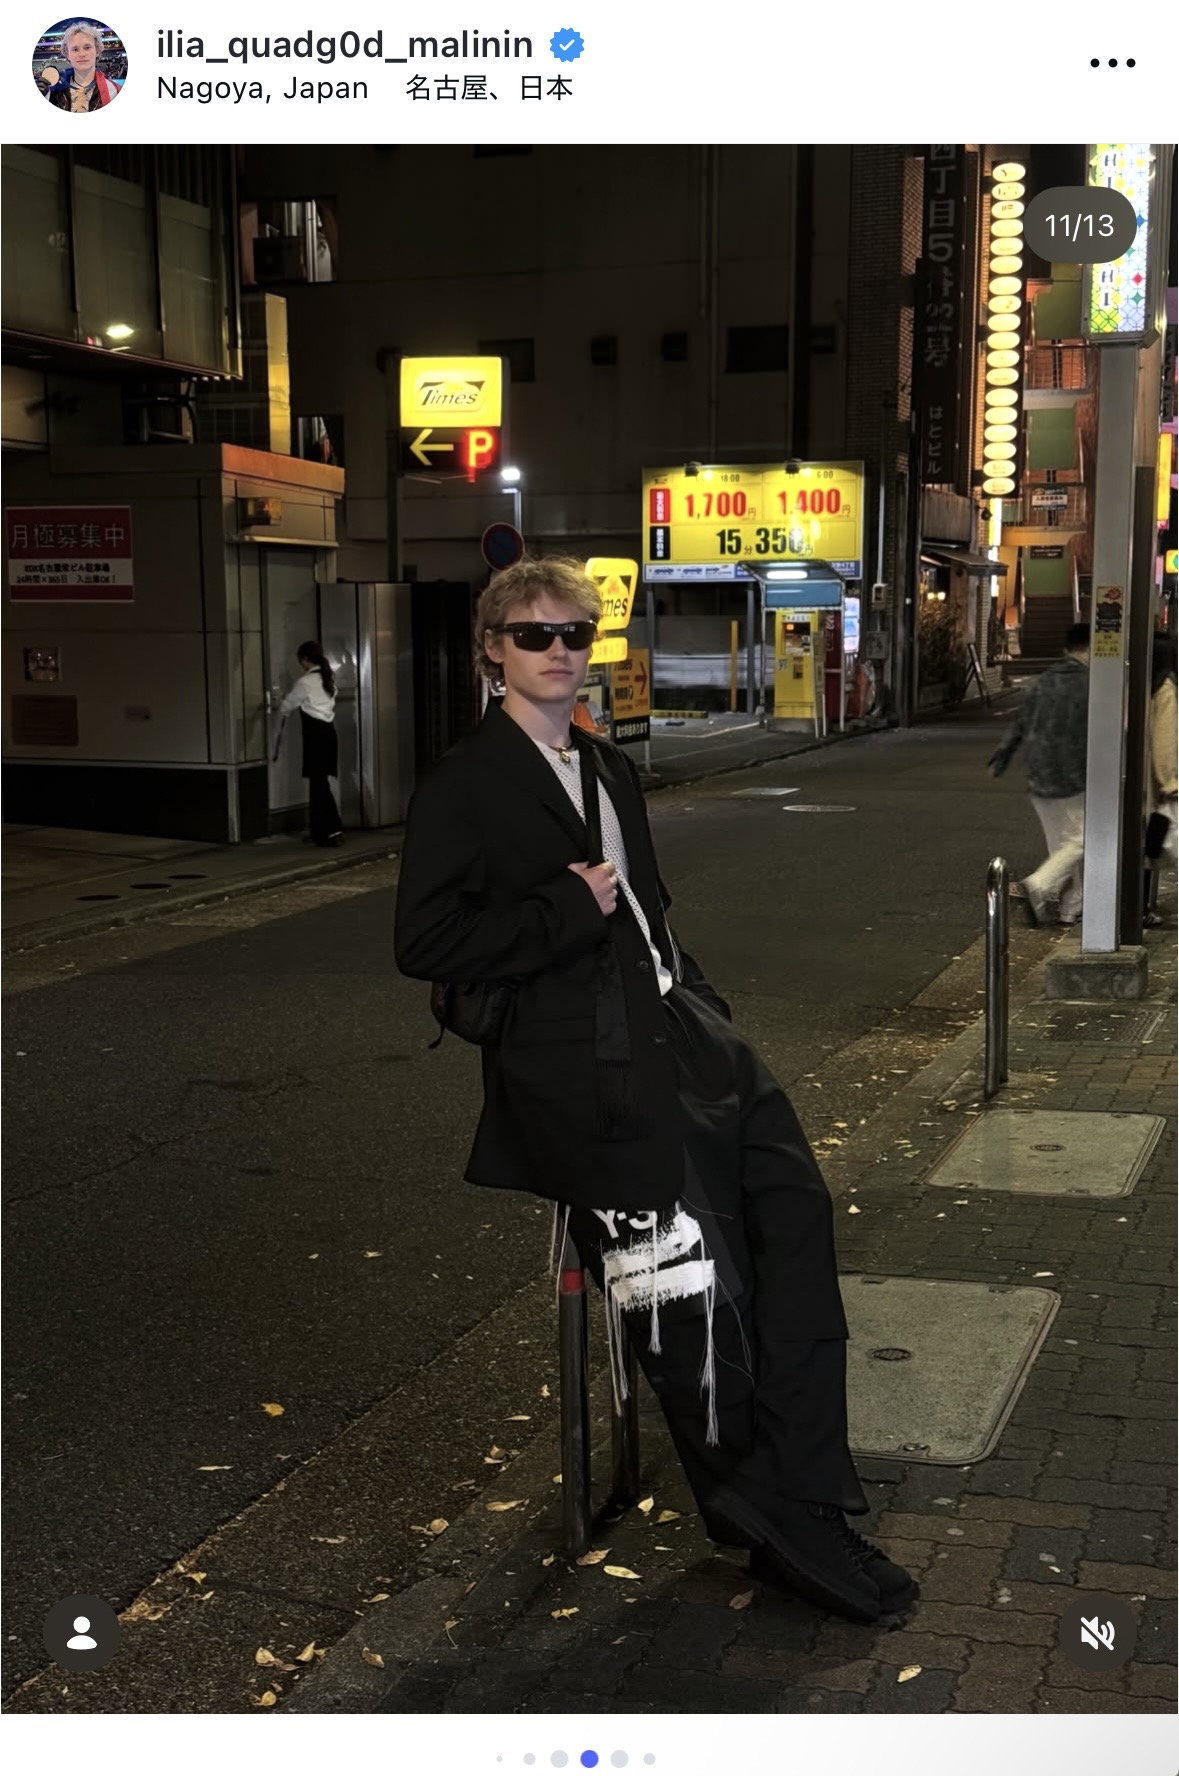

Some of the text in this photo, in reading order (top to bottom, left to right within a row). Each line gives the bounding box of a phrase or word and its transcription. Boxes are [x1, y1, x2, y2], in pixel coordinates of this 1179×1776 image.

[420, 380, 485, 406] Times
[467, 430, 494, 468] P
[12, 522, 125, 549] 月極募集中
